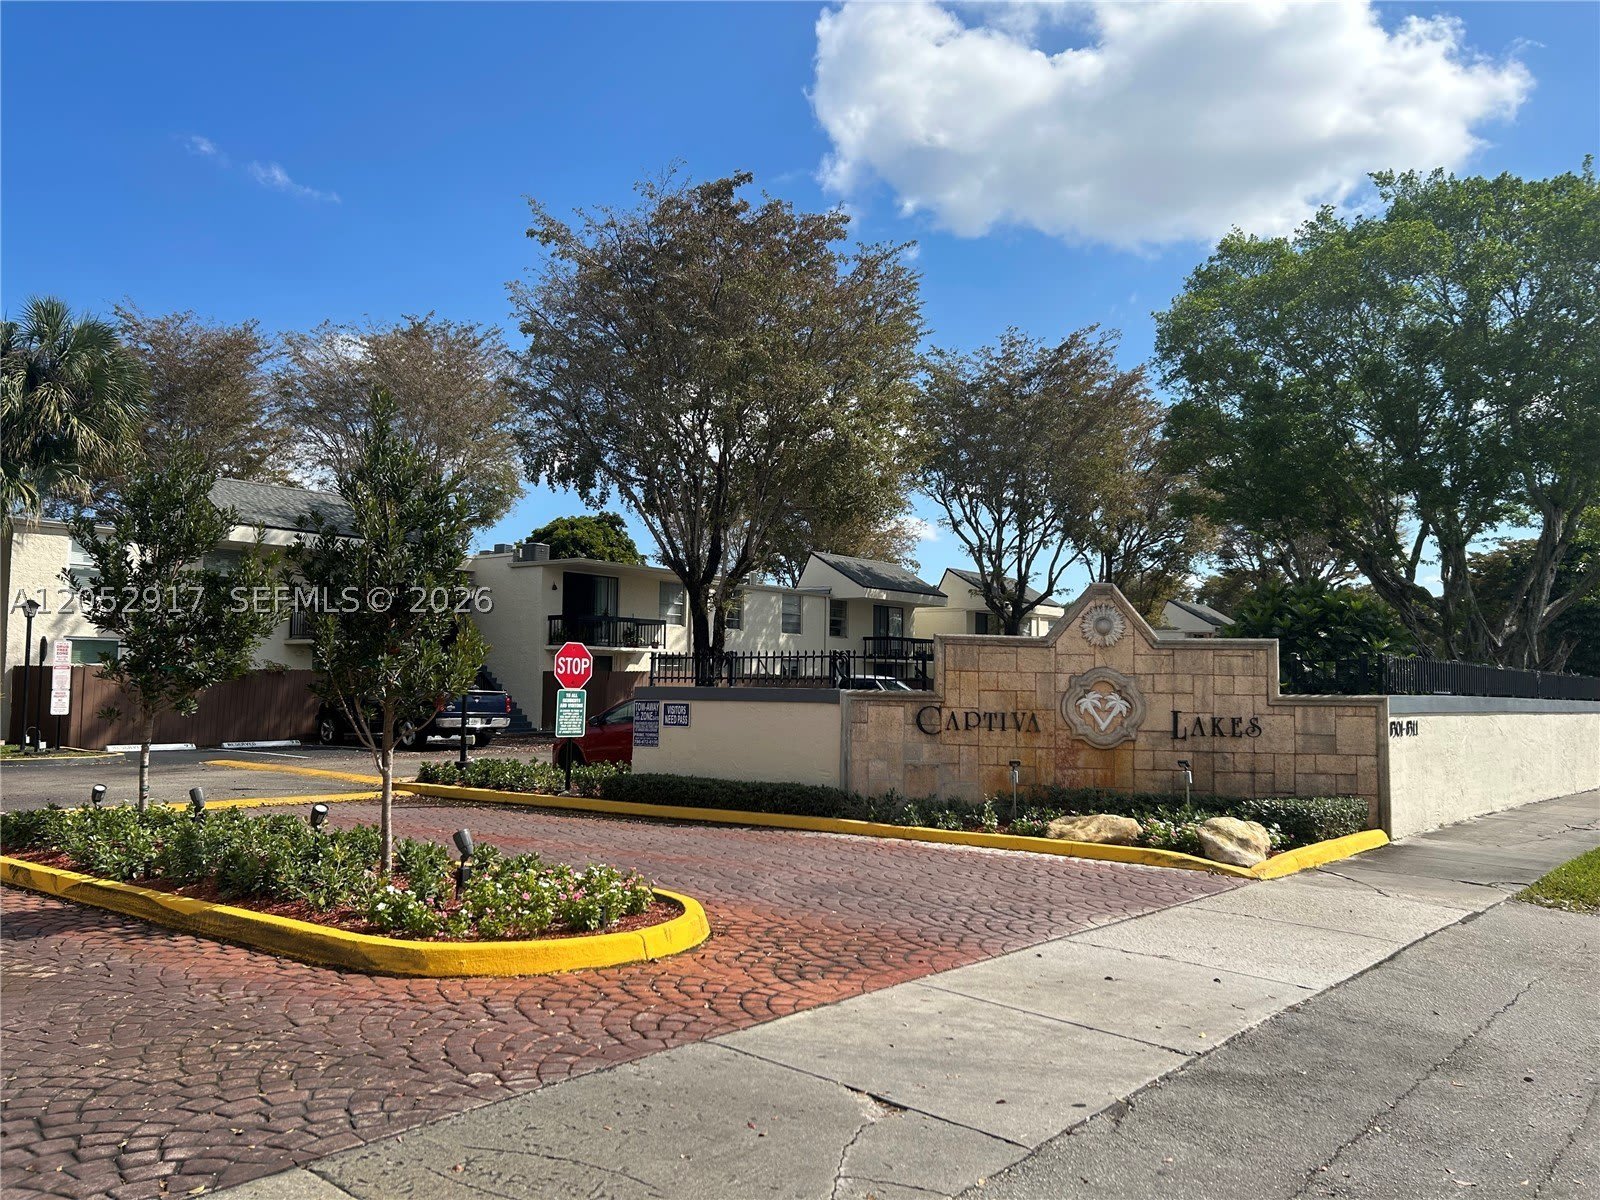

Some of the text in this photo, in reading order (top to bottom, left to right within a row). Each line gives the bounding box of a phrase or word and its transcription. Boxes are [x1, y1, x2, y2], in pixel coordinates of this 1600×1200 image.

[557, 656, 590, 675] STOP
[635, 702, 660, 711] TOW-AWAY
[667, 705, 687, 715] VISITORS
[640, 711, 654, 720] ZONE
[664, 715, 678, 724] NEED
[677, 715, 688, 724] PASS
